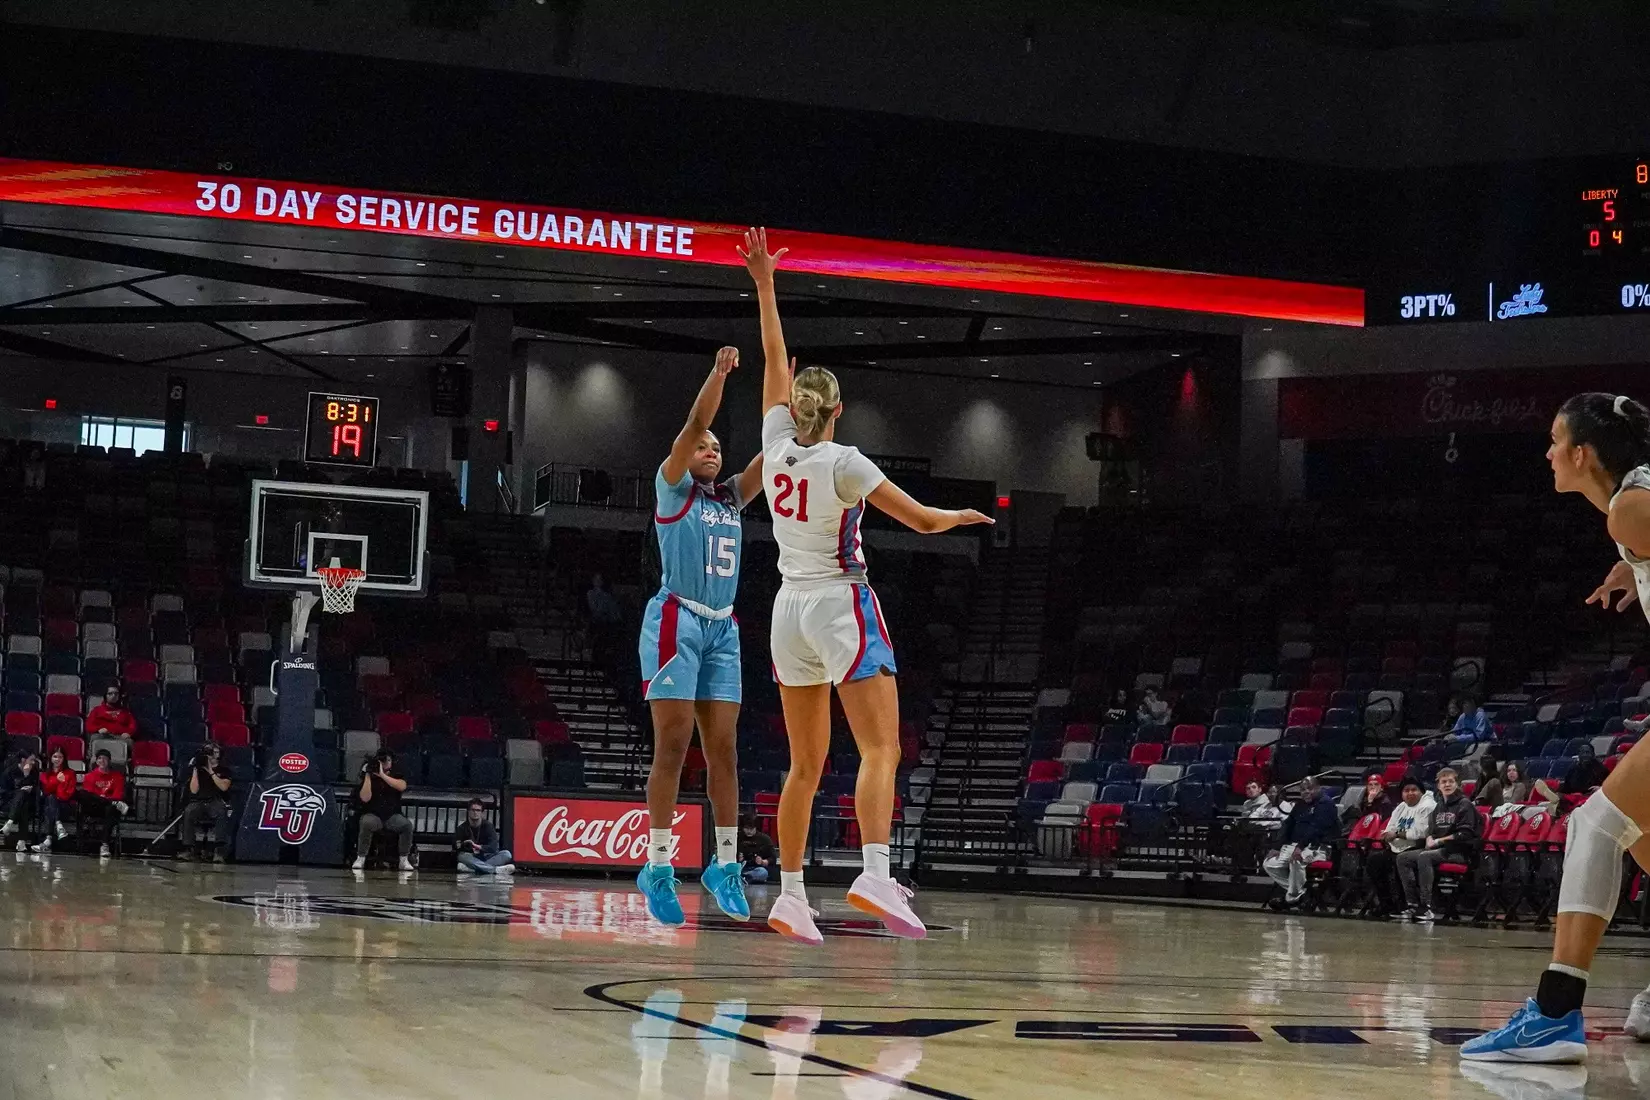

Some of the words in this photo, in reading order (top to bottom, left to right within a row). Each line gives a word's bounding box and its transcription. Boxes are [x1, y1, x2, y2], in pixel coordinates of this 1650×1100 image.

[1582, 188, 1618, 201] LIBERTY
[196, 181, 242, 213] 30
[255, 186, 322, 220] DAY
[336, 194, 480, 235] SERVICE
[494, 209, 694, 256] GUARANTEE
[1603, 200, 1615, 221] 5
[1589, 229, 1600, 247] 0
[1612, 229, 1622, 244] 4
[1400, 293, 1456, 318] 3PT%
[1621, 283, 1650, 308] 0%
[327, 401, 370, 422] 8:31
[333, 424, 361, 457] 19
[773, 473, 809, 523] 21
[705, 535, 736, 577] 15
[283, 661, 315, 670] SPALDING
[258, 793, 317, 845] LU
